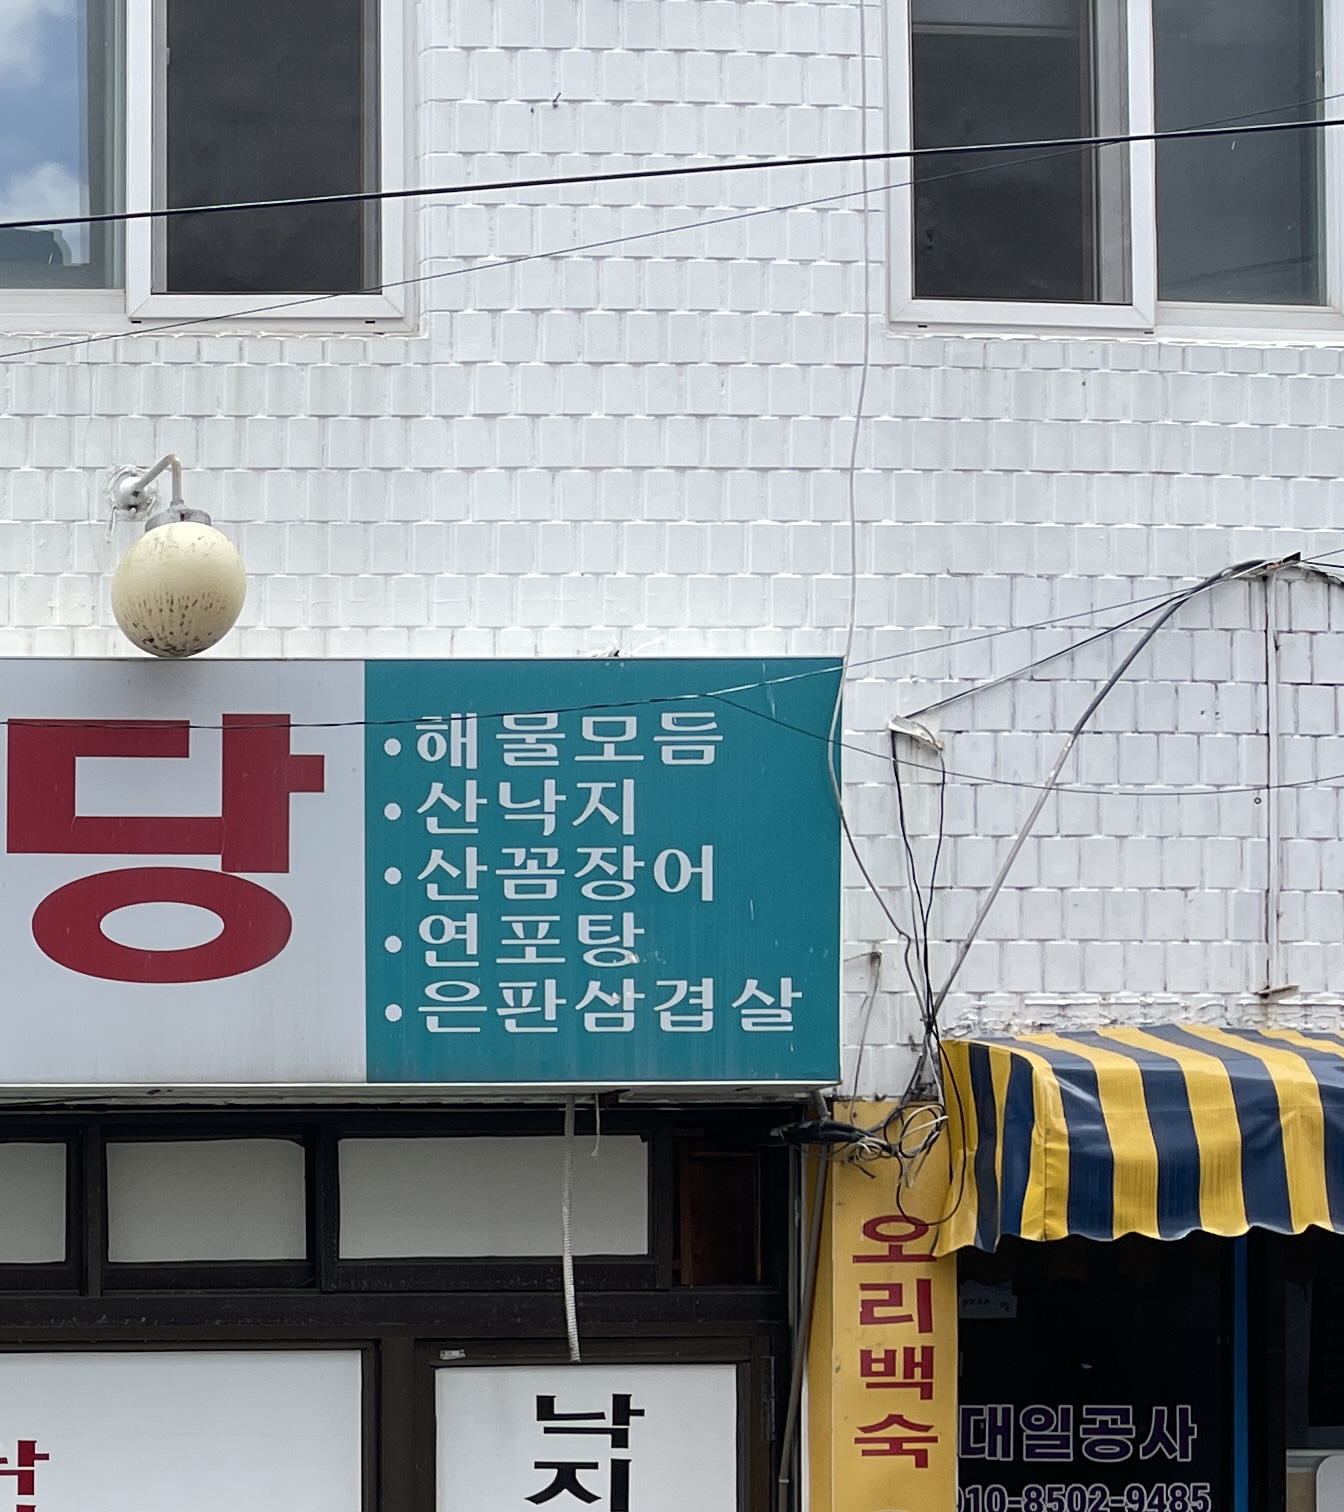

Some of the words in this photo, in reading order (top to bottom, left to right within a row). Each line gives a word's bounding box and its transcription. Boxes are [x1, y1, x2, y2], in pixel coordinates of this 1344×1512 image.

[415, 711, 723, 769] 해물모듬
[417, 778, 636, 836] 산낙지
[417, 845, 714, 902] 산꼼장어
[417, 911, 645, 968] 연포탕
[417, 976, 803, 1033] 은판삼겹살
[852, 1215, 940, 1469] 오리백숙
[959, 1404, 1197, 1462] 대일공사
